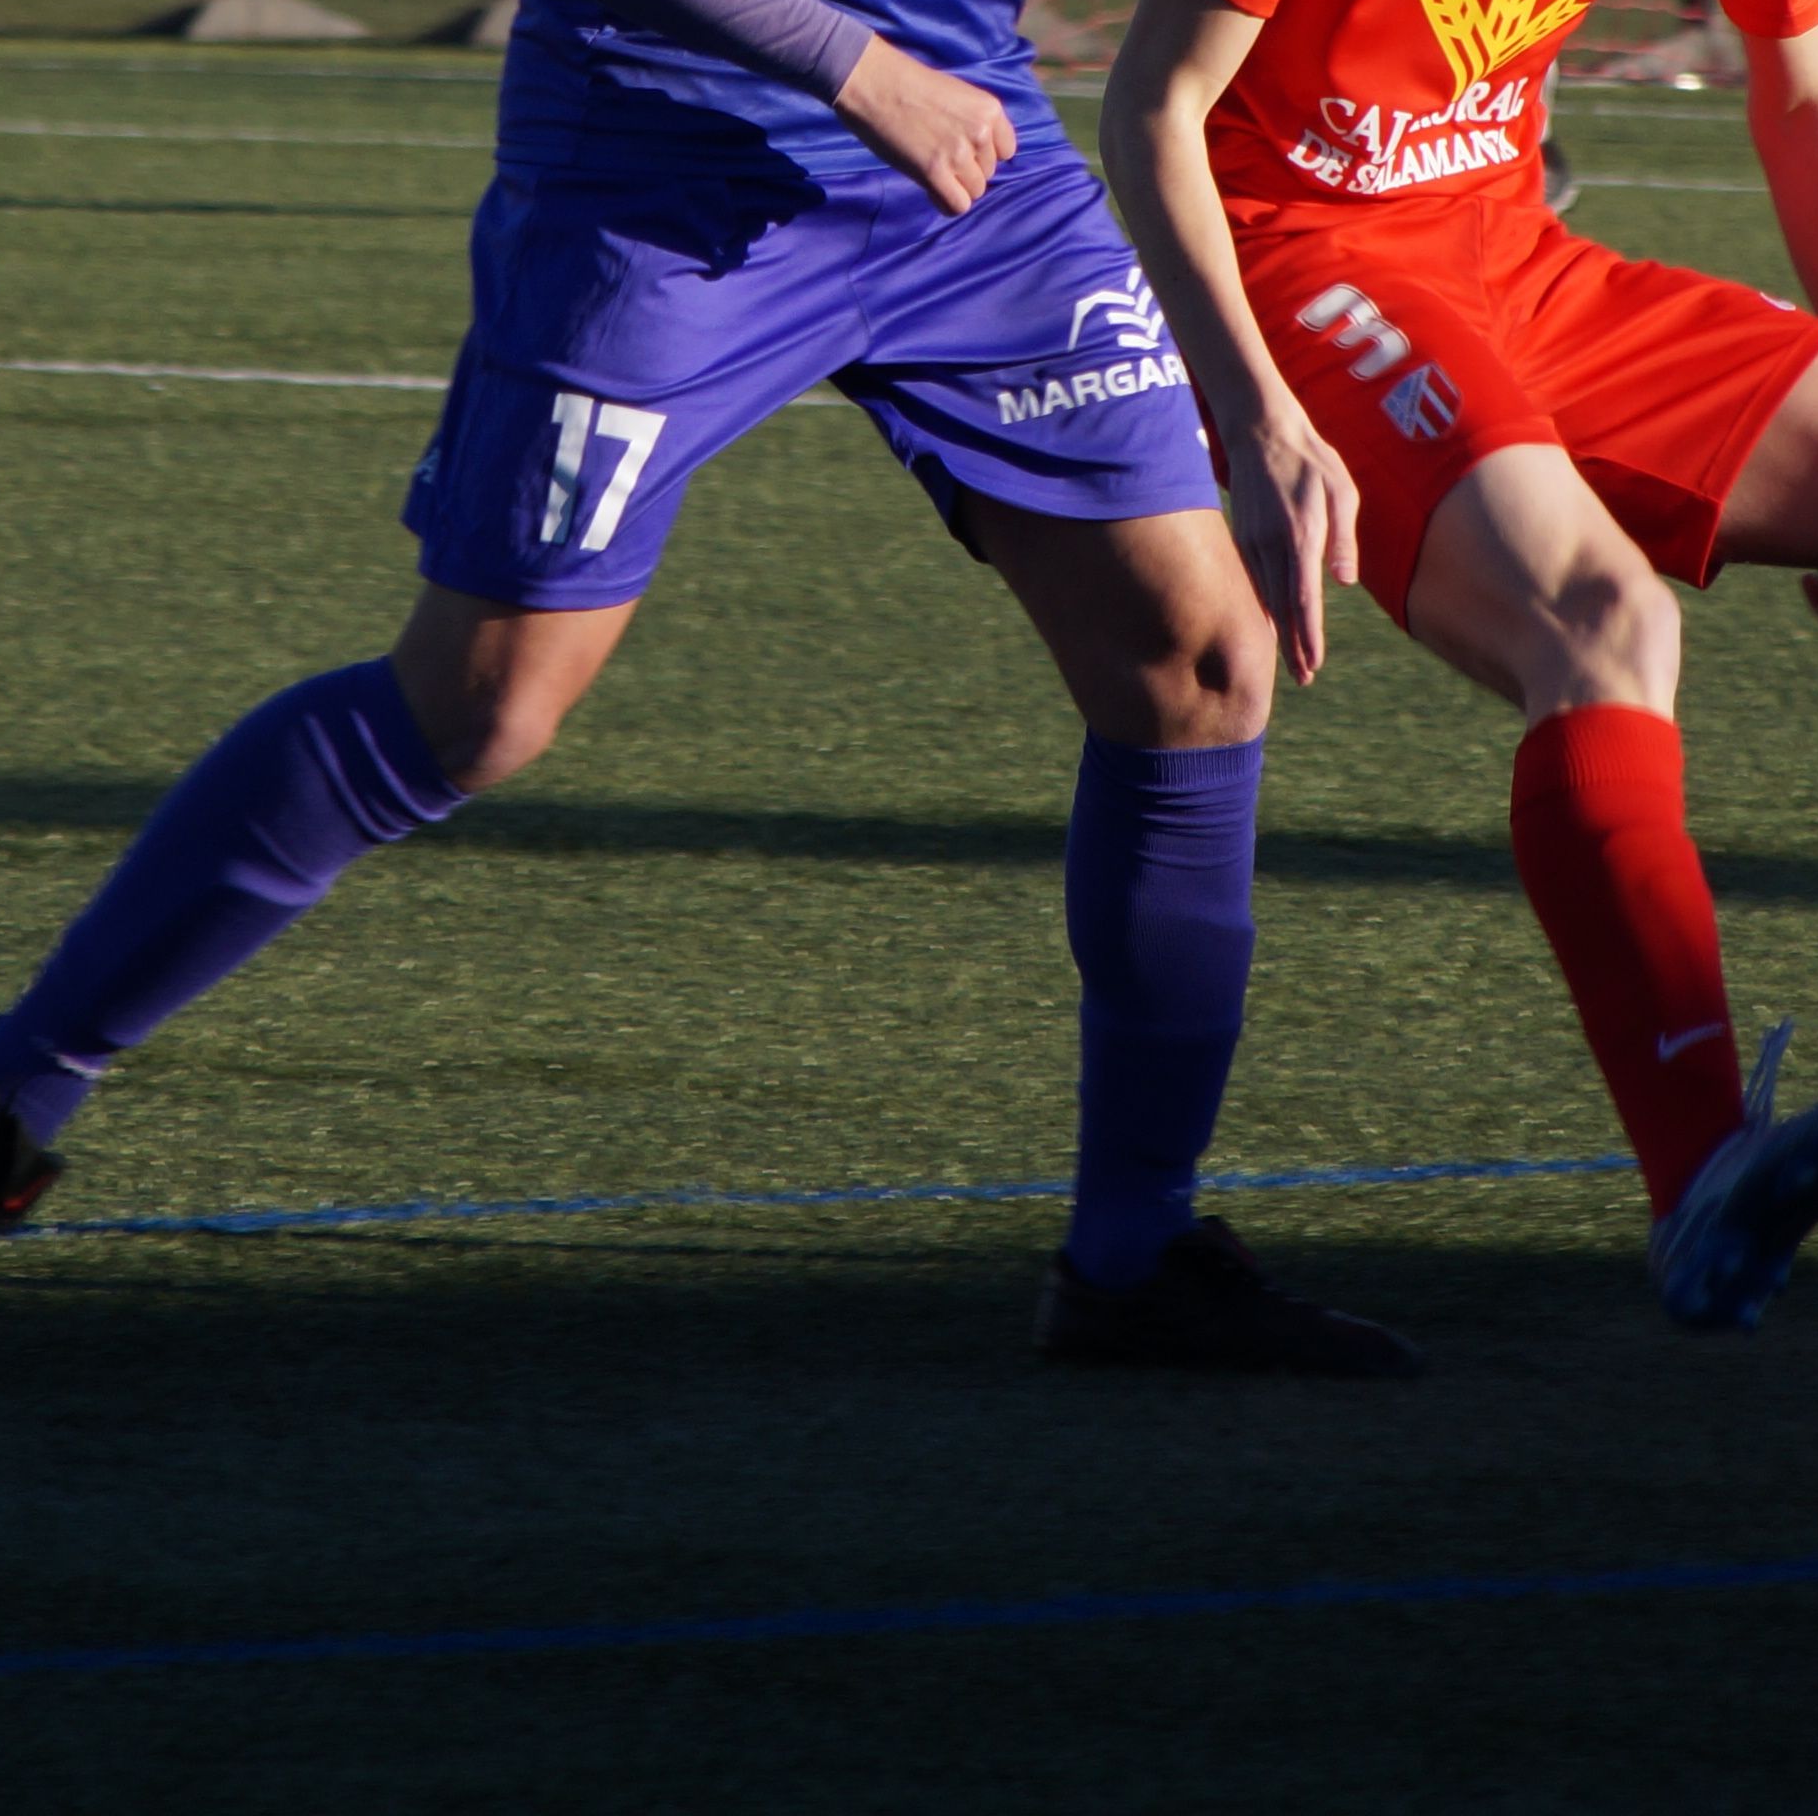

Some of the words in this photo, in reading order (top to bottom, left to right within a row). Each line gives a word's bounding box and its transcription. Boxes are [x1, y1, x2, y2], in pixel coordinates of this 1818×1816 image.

[1287, 128, 1353, 188] DE
[1347, 125, 1520, 195] SALAMANA
[1295, 283, 1411, 382] 3
[539, 392, 668, 552] 17
